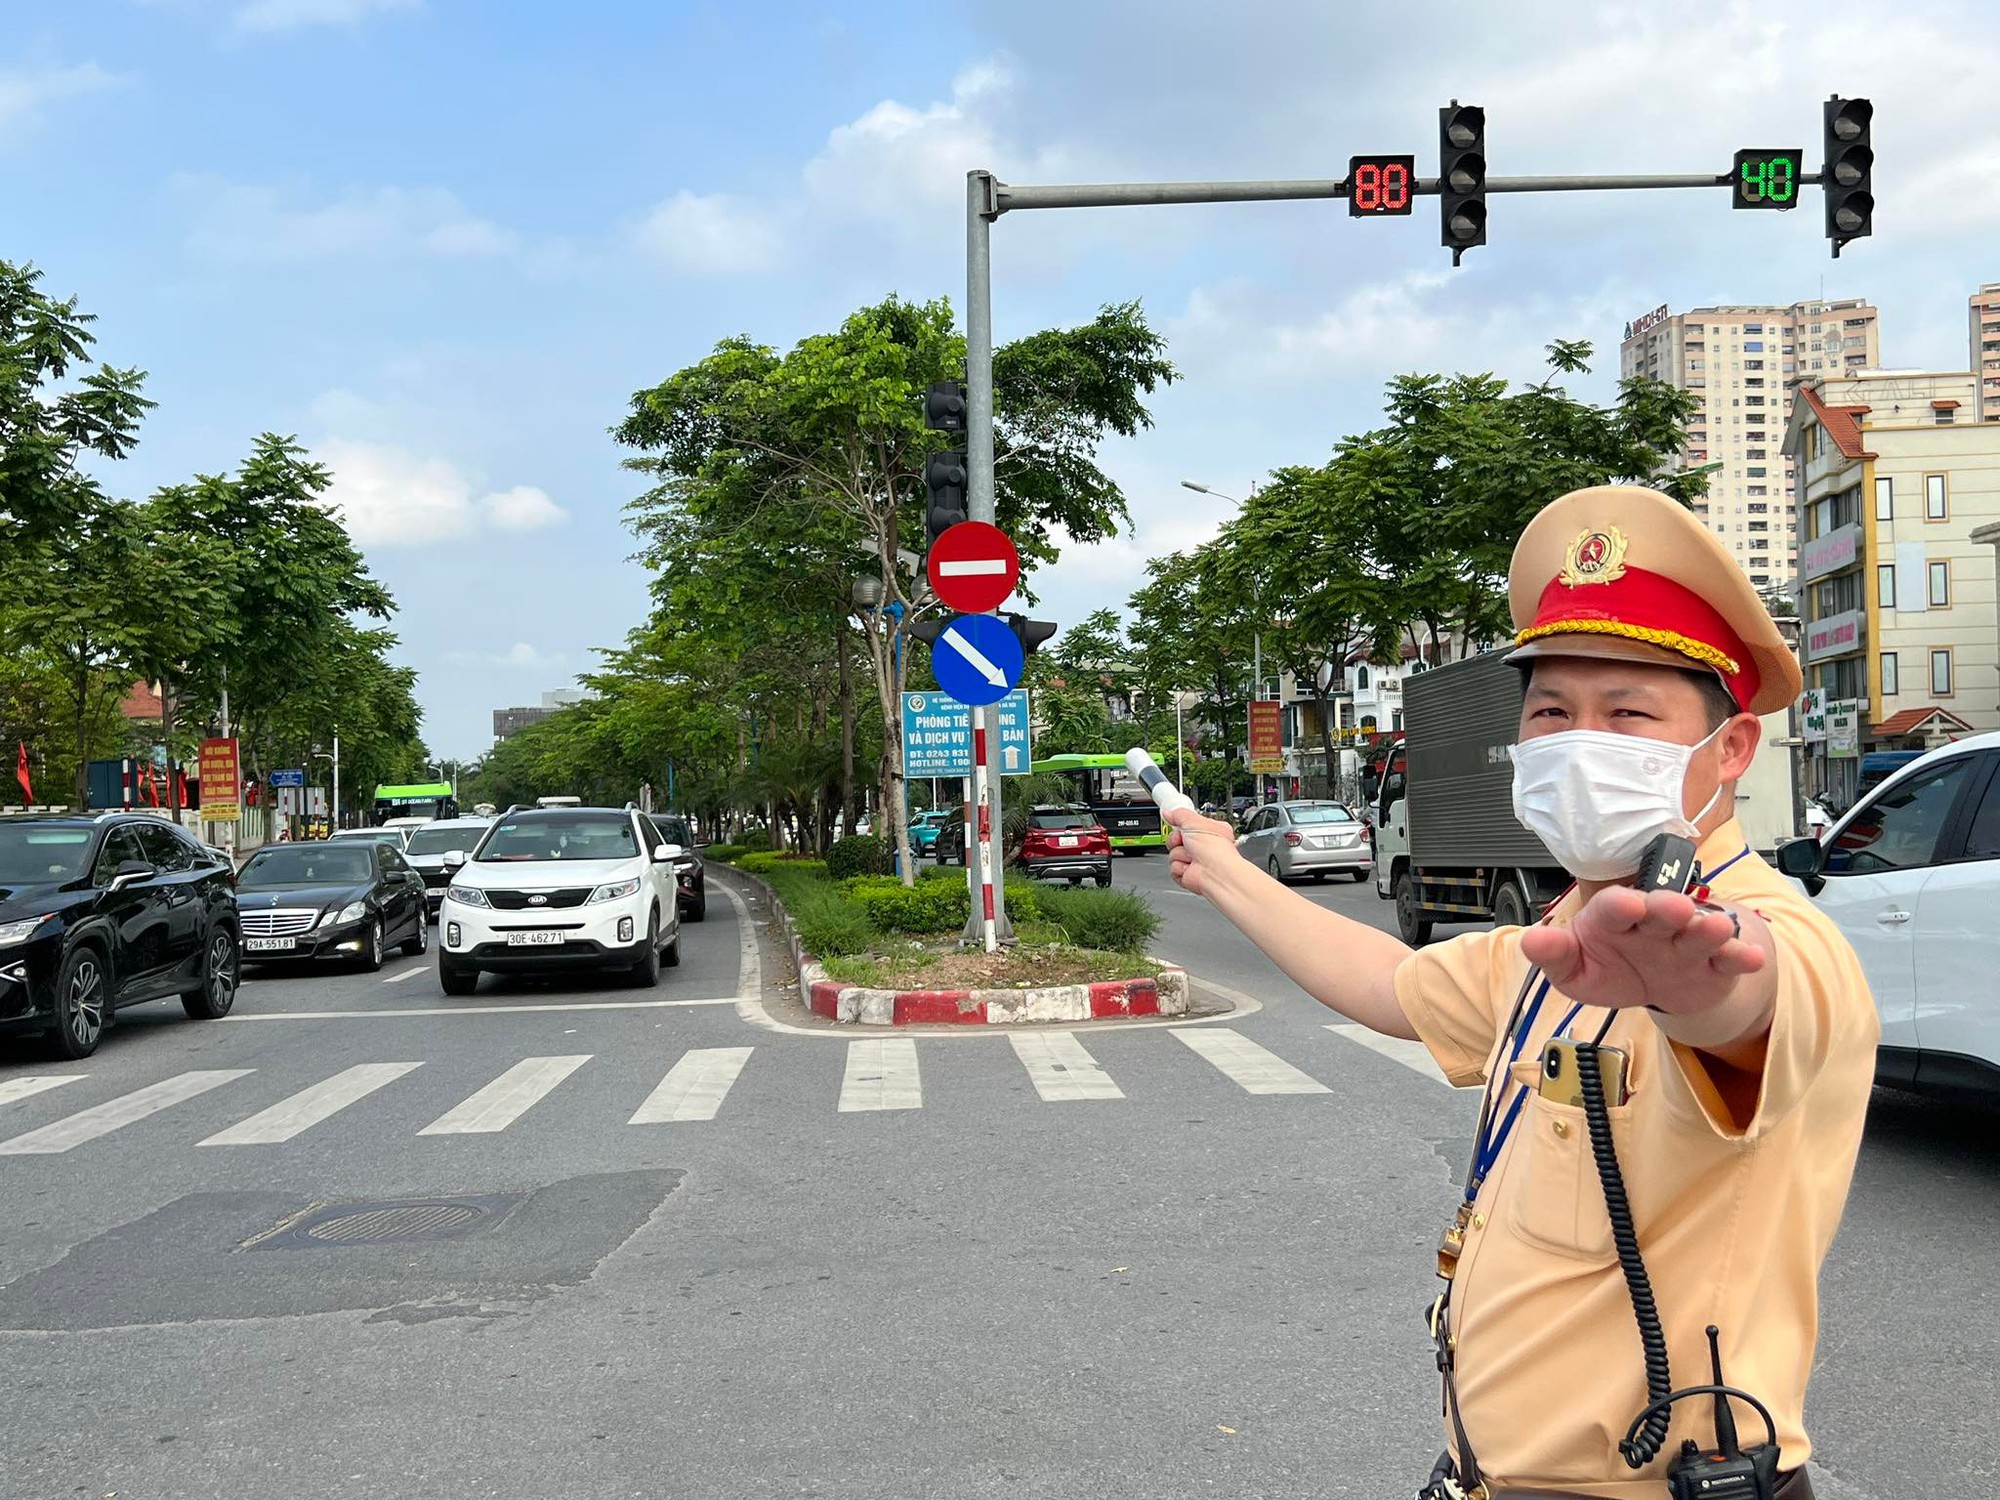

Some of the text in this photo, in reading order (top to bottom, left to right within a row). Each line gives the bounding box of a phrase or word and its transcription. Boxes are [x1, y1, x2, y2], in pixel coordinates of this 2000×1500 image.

[1356, 164, 1407, 209] 80
[1742, 158, 1792, 201] 40
[916, 714, 950, 728] PHÒNG
[953, 713, 969, 727] TIÊ
[909, 732, 922, 745] VÀ
[925, 732, 949, 746] DỊCH
[952, 732, 965, 745] VỤ
[910, 759, 950, 768] HOTLINE:
